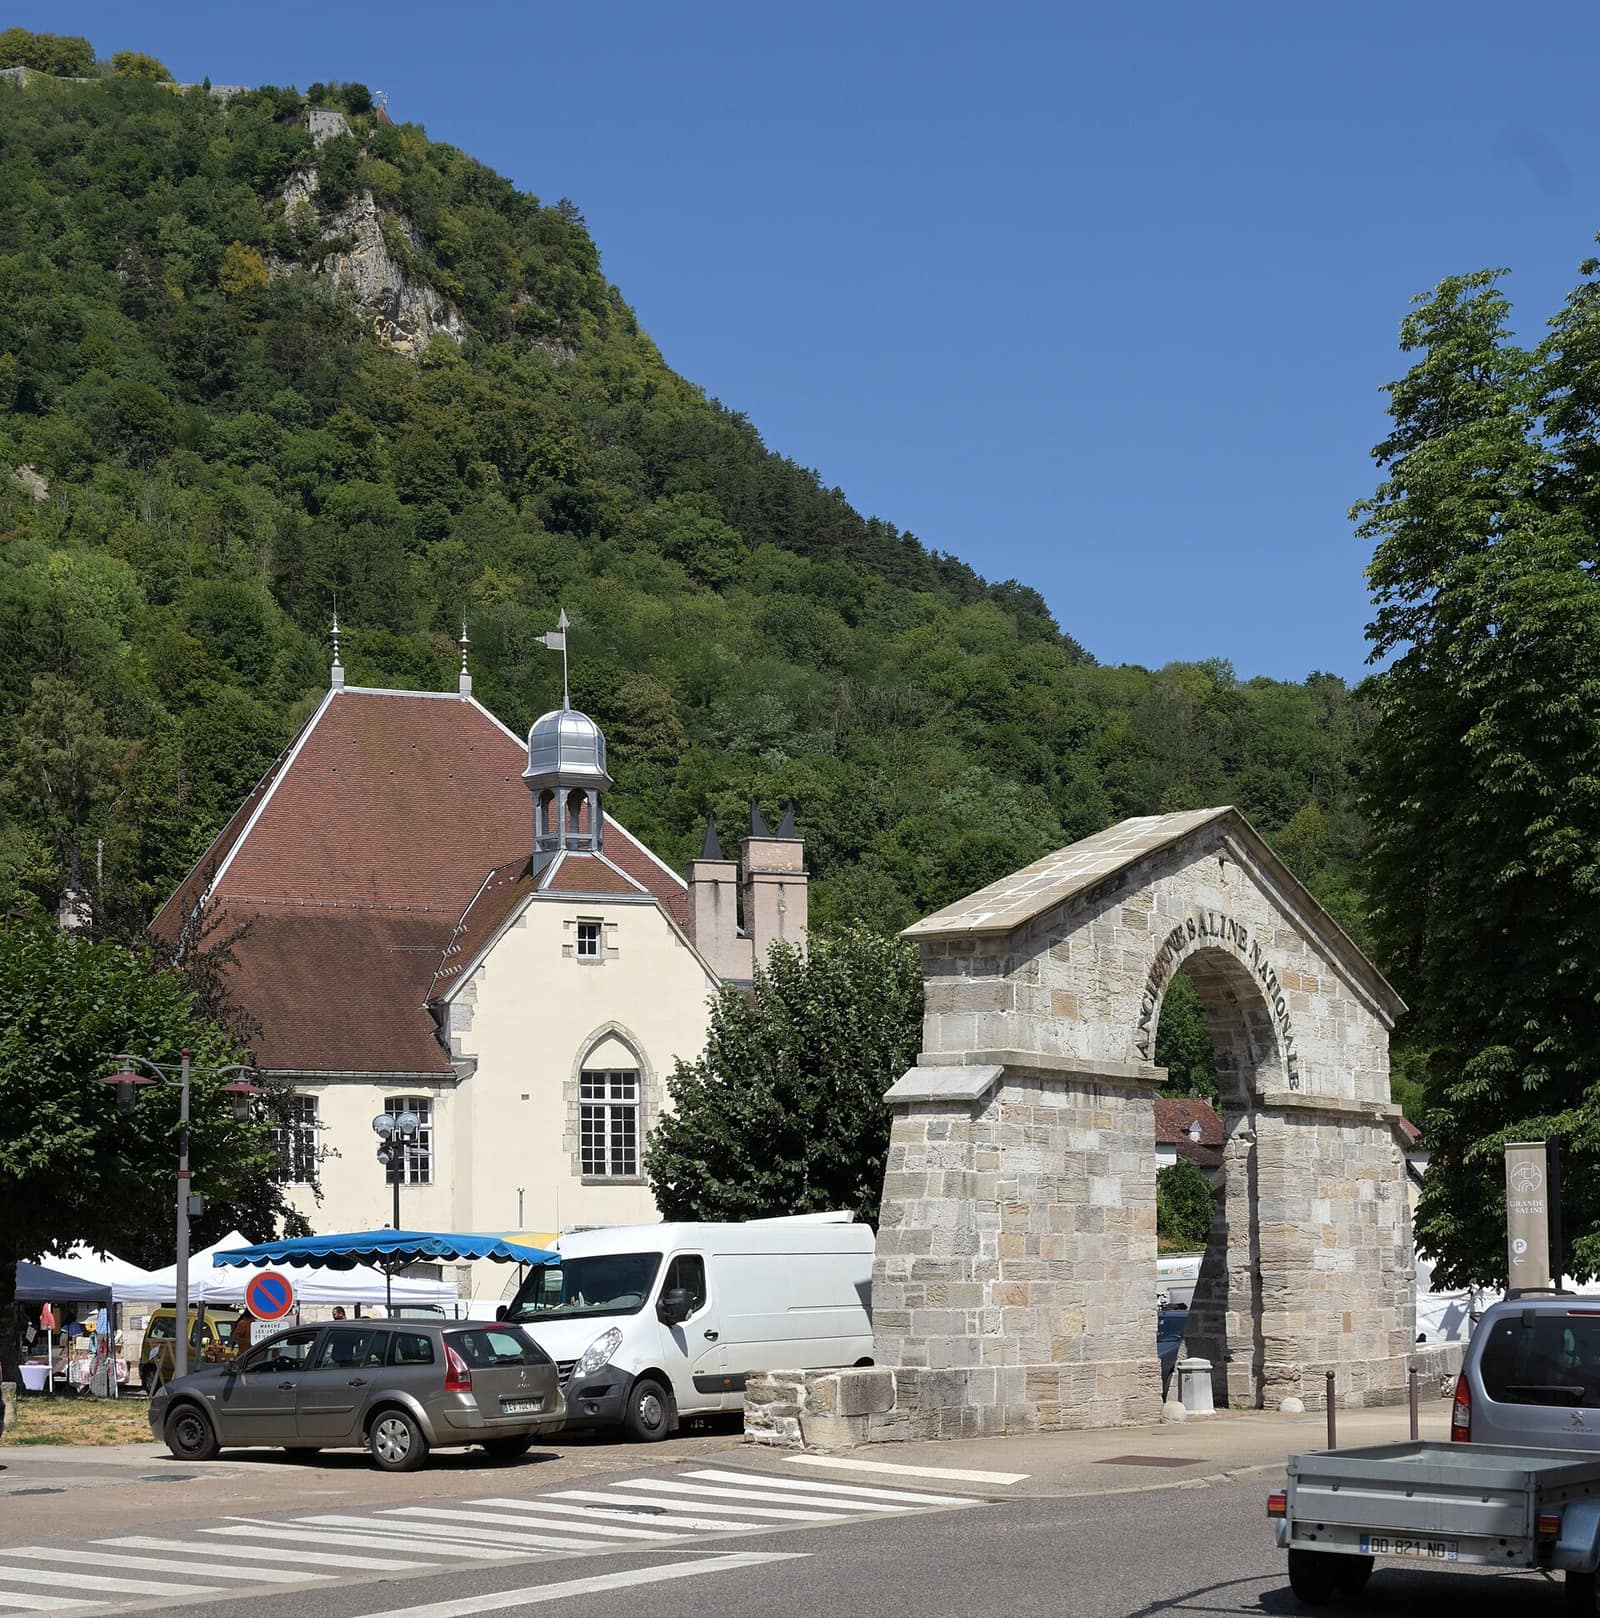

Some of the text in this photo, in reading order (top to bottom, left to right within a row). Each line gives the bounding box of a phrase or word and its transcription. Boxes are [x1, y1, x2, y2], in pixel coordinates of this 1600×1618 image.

[1186, 913, 1249, 952] SALINE
[1250, 940, 1300, 1090] NATIONALE
[1371, 1538, 1446, 1558] DD-821-ND
[1448, 1552, 1457, 1560] 25
